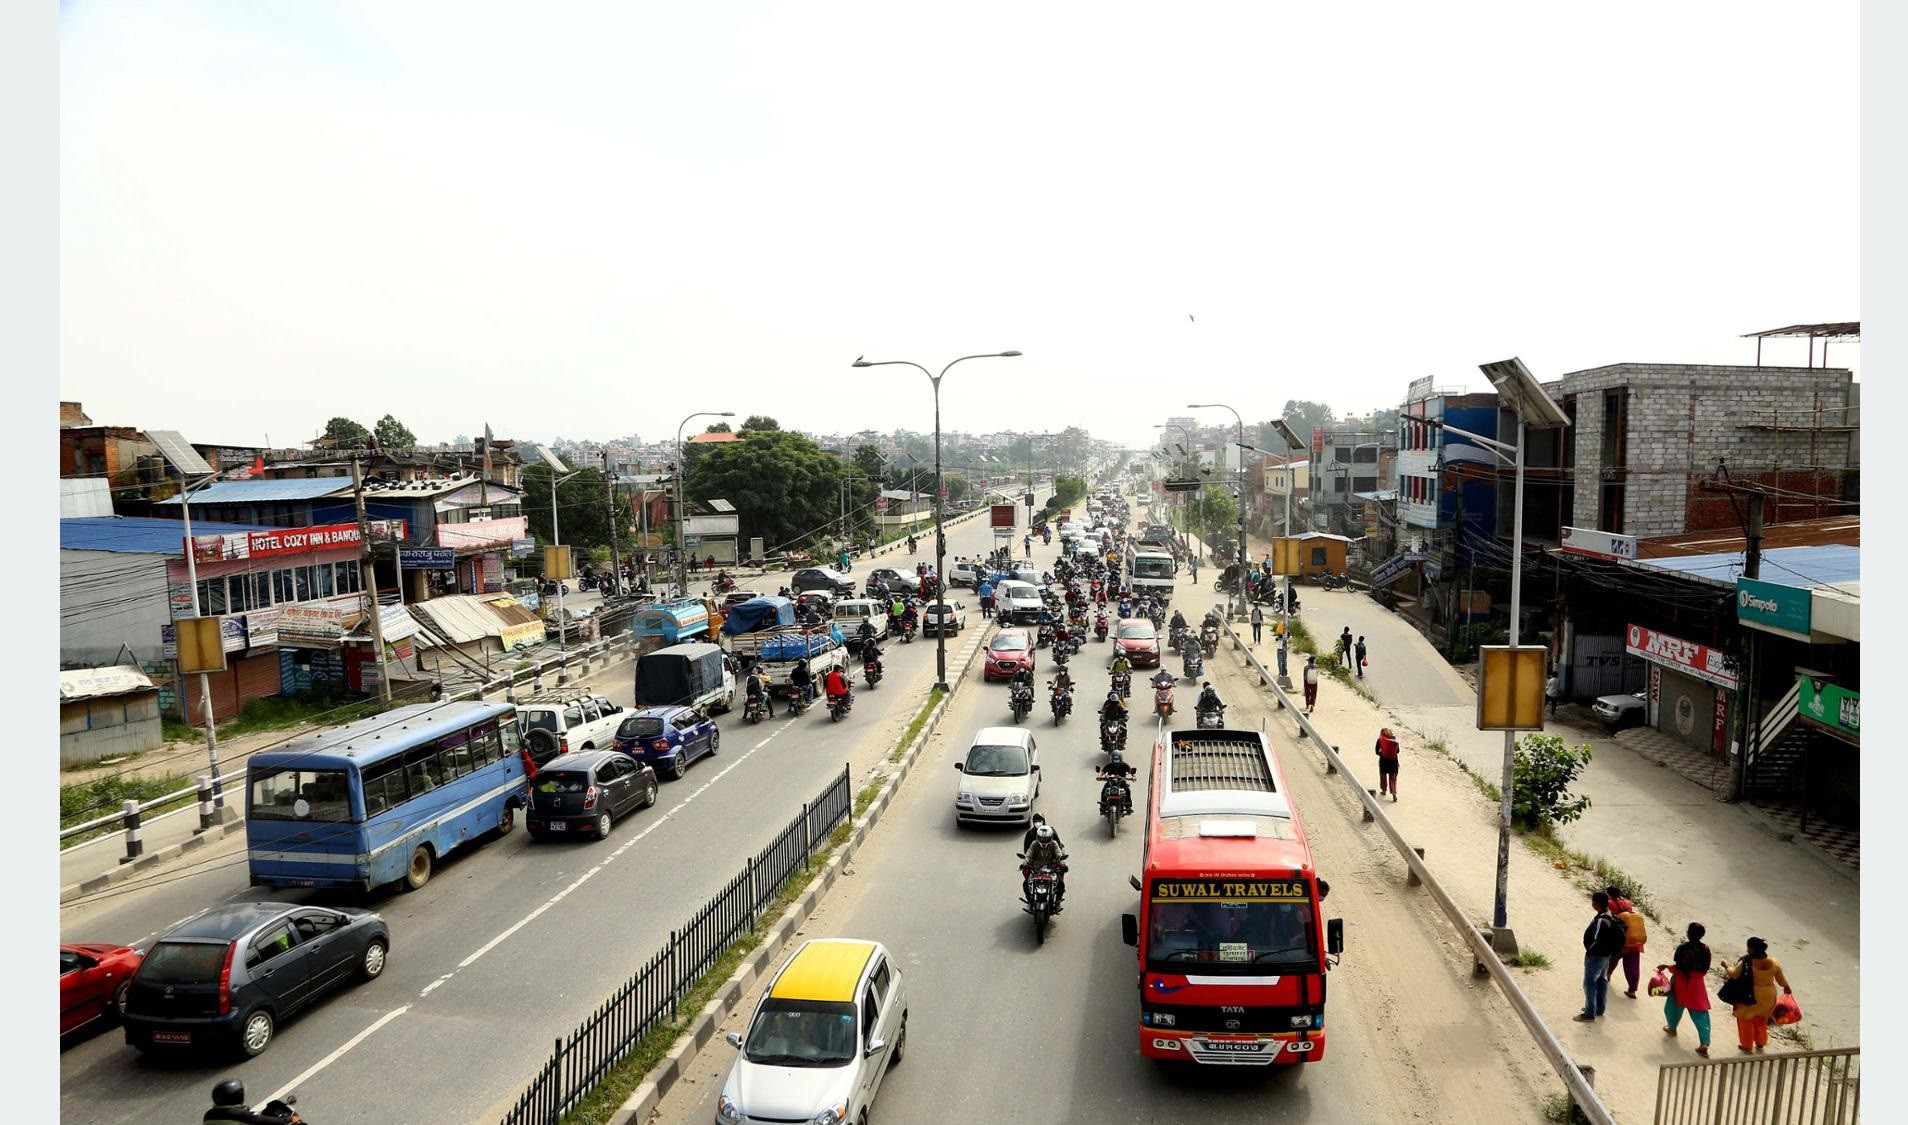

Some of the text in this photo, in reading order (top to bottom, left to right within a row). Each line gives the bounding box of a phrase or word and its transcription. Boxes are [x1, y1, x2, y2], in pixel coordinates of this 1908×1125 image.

[252, 536, 281, 551] HOTEL
[284, 534, 308, 548] COZY
[309, 532, 323, 546] INN
[324, 532, 331, 544] &
[1748, 594, 1777, 613] Simpolo
[1645, 629, 1699, 665] MRF
[1586, 655, 1621, 667] TVS
[1716, 689, 1727, 731] MRF
[1158, 883, 1303, 897] SUWAL TRAVELS
